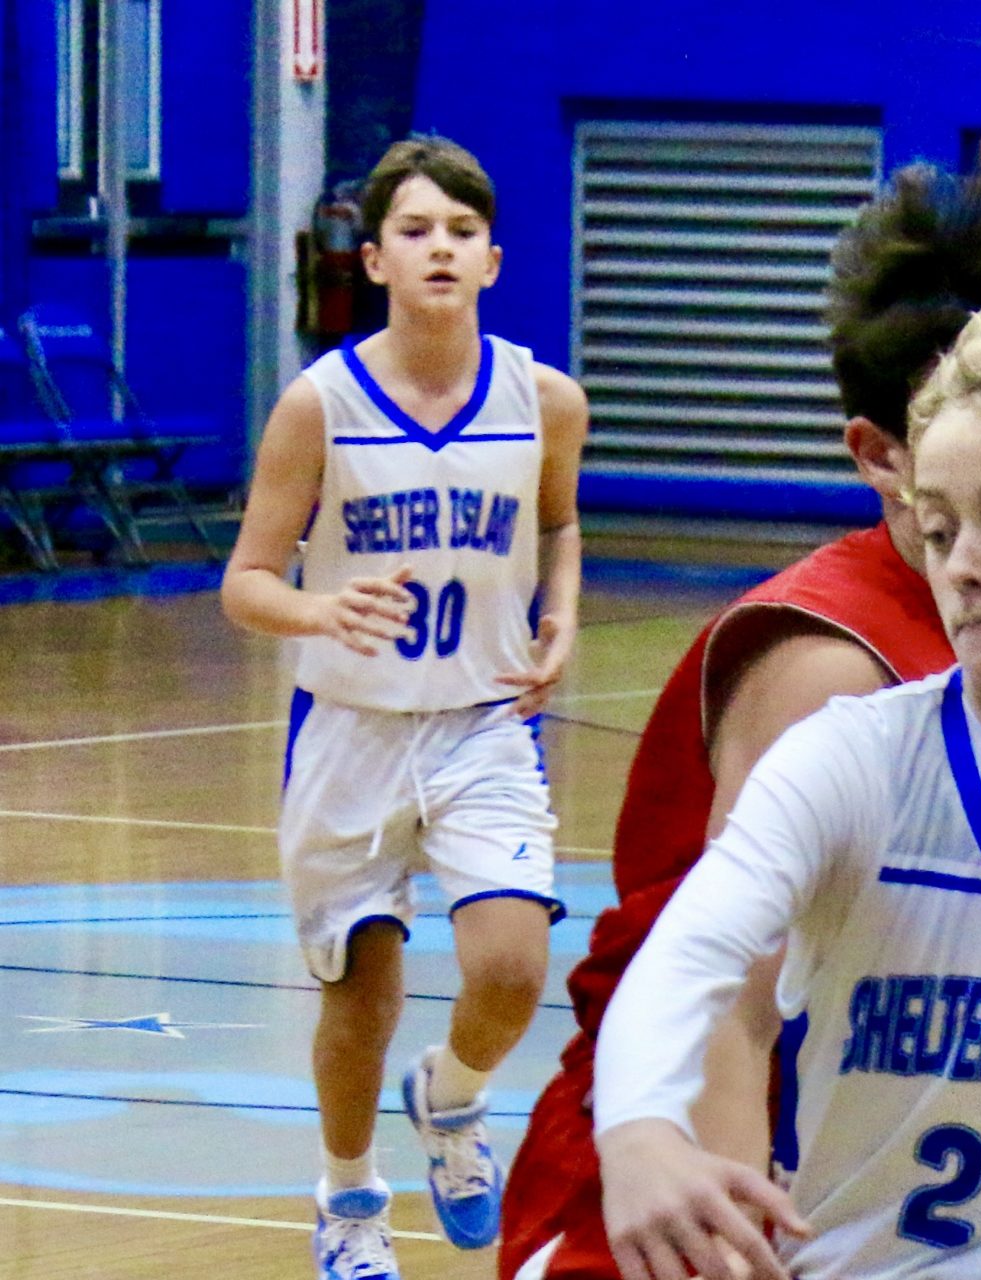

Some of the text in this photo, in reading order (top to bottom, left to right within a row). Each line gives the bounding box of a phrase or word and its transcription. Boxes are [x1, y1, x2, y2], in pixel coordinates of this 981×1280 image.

[342, 486, 520, 557] SHELTER ISLAN
[395, 576, 468, 662] 30
